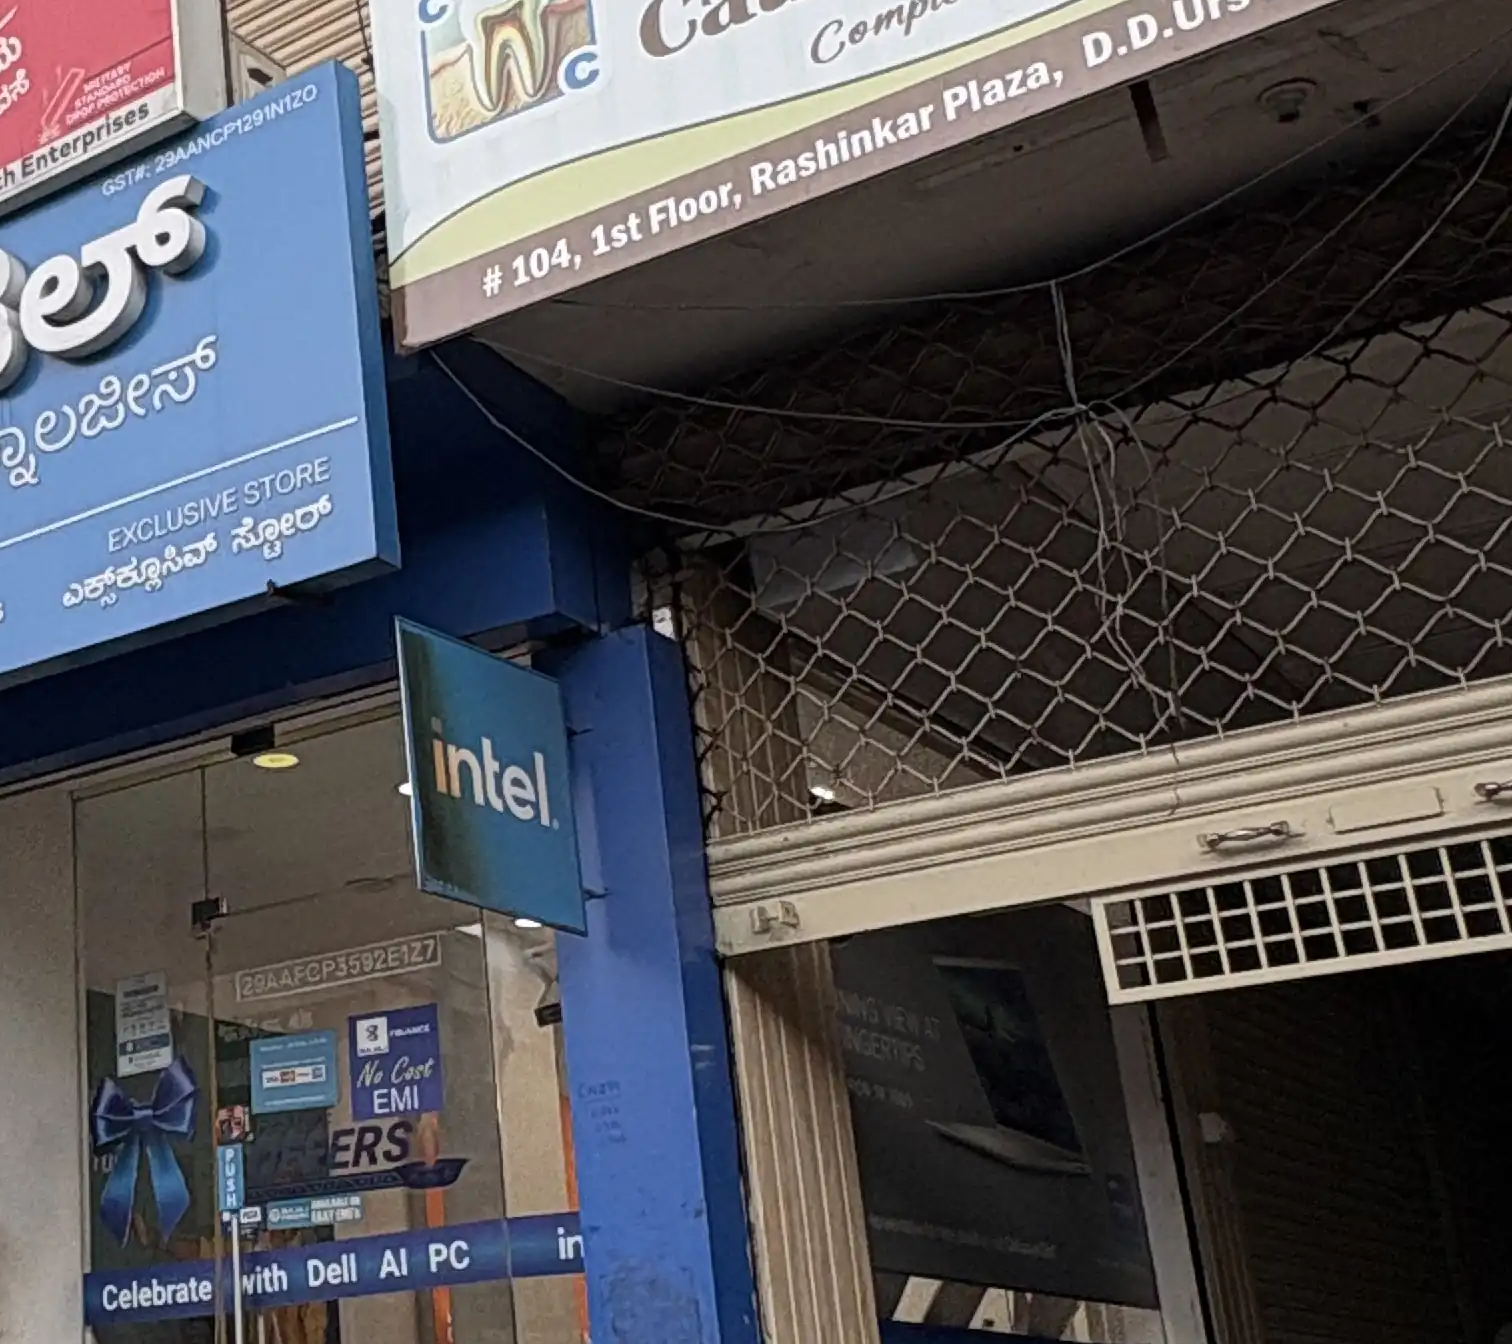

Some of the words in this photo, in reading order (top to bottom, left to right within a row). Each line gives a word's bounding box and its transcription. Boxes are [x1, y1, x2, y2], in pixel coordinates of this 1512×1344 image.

[21, 101, 150, 176] Enterprises
[482, 265, 503, 297] #
[511, 239, 583, 290] 104,
[591, 215, 643, 257] 1st
[648, 179, 743, 235] Floor,
[750, 104, 933, 193] Rashinkar
[941, 64, 1065, 115] Plaza,
[106, 487, 238, 553] EXCLUSIVE
[243, 456, 332, 507] STORE
[356, 1062, 384, 1089] No
[389, 1056, 434, 1083] Cost
[372, 1087, 421, 1115] EMI
[224, 1147, 238, 1208] PUSH
[101, 1277, 213, 1311] Celebrate
[306, 1251, 358, 1288] Dell
[379, 1249, 409, 1280] AI
[428, 1240, 471, 1273] PC
